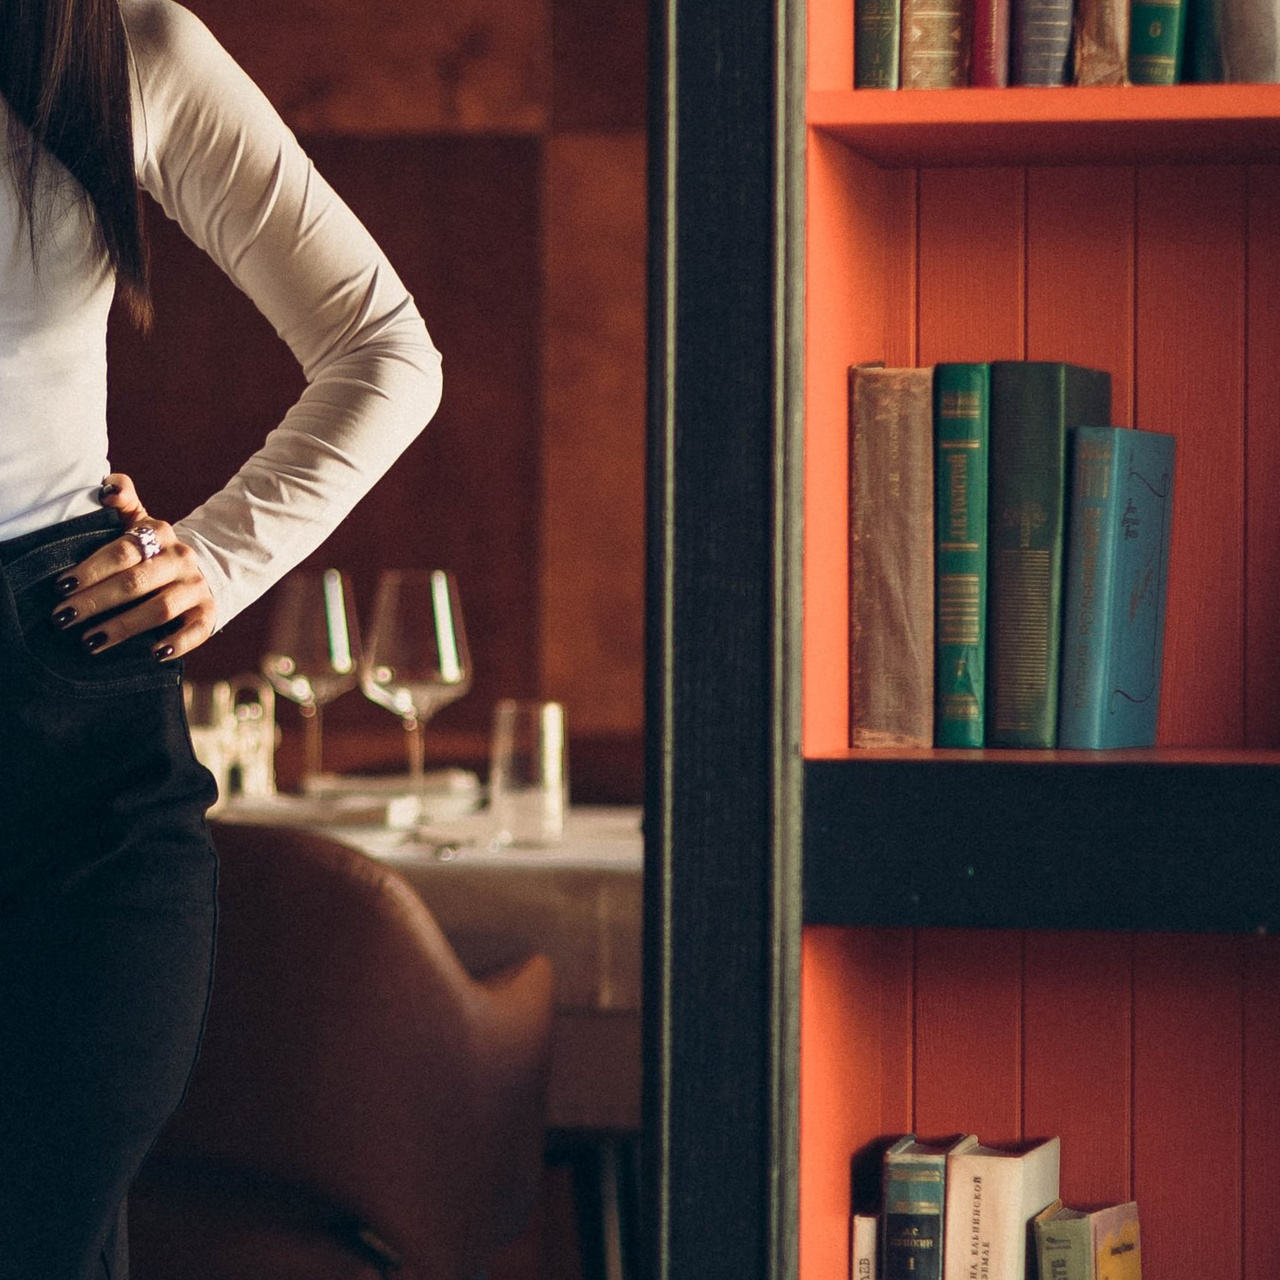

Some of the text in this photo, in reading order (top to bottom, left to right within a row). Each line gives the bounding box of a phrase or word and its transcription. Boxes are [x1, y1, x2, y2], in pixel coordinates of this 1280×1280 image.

[969, 1175, 983, 1280] НА ЕЛЬНИНСКОЙ
[980, 1240, 991, 1280] ЗЕМЛЕ
